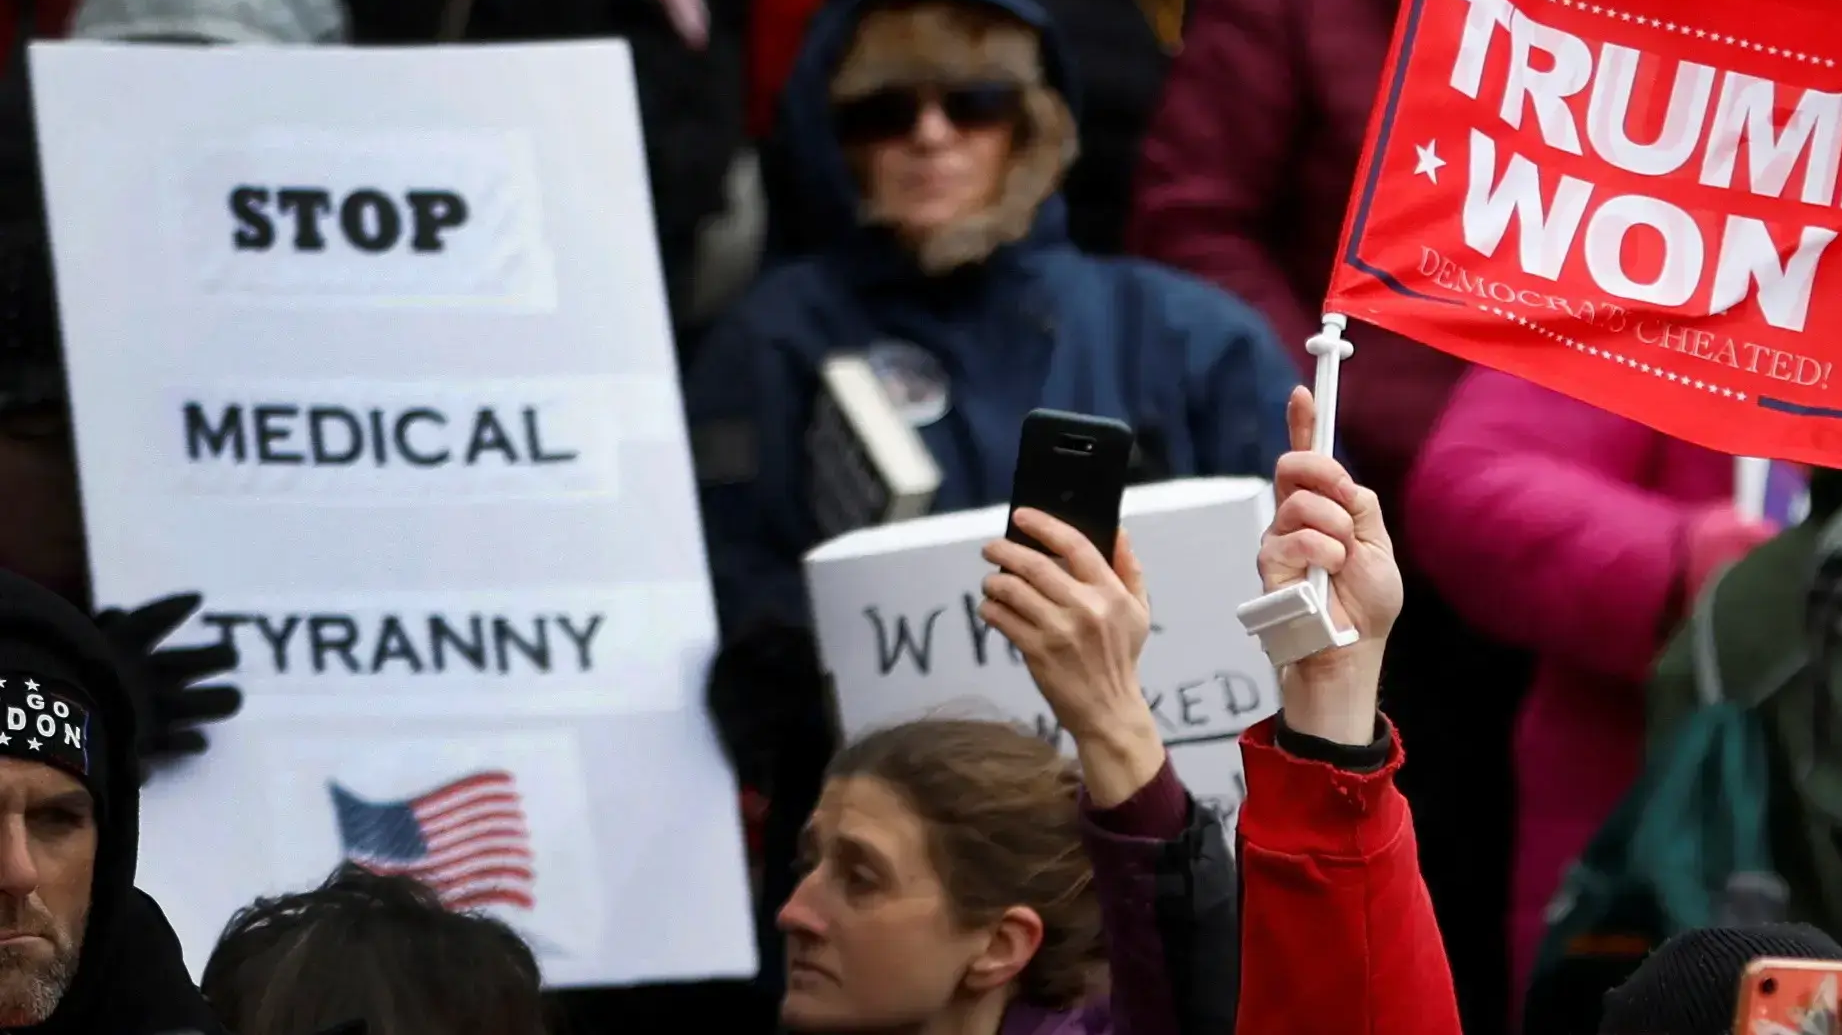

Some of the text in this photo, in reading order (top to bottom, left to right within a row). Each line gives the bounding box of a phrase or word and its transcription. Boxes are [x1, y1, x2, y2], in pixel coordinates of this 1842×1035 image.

[229, 186, 469, 252] STOP
[1461, 127, 1838, 331] WON
[1635, 319, 1832, 389] CHEATED!
[183, 402, 578, 466] MEDICAL
[202, 612, 605, 674] TYRANNY
[7, 706, 80, 749] DON
[26, 694, 69, 718] GO
